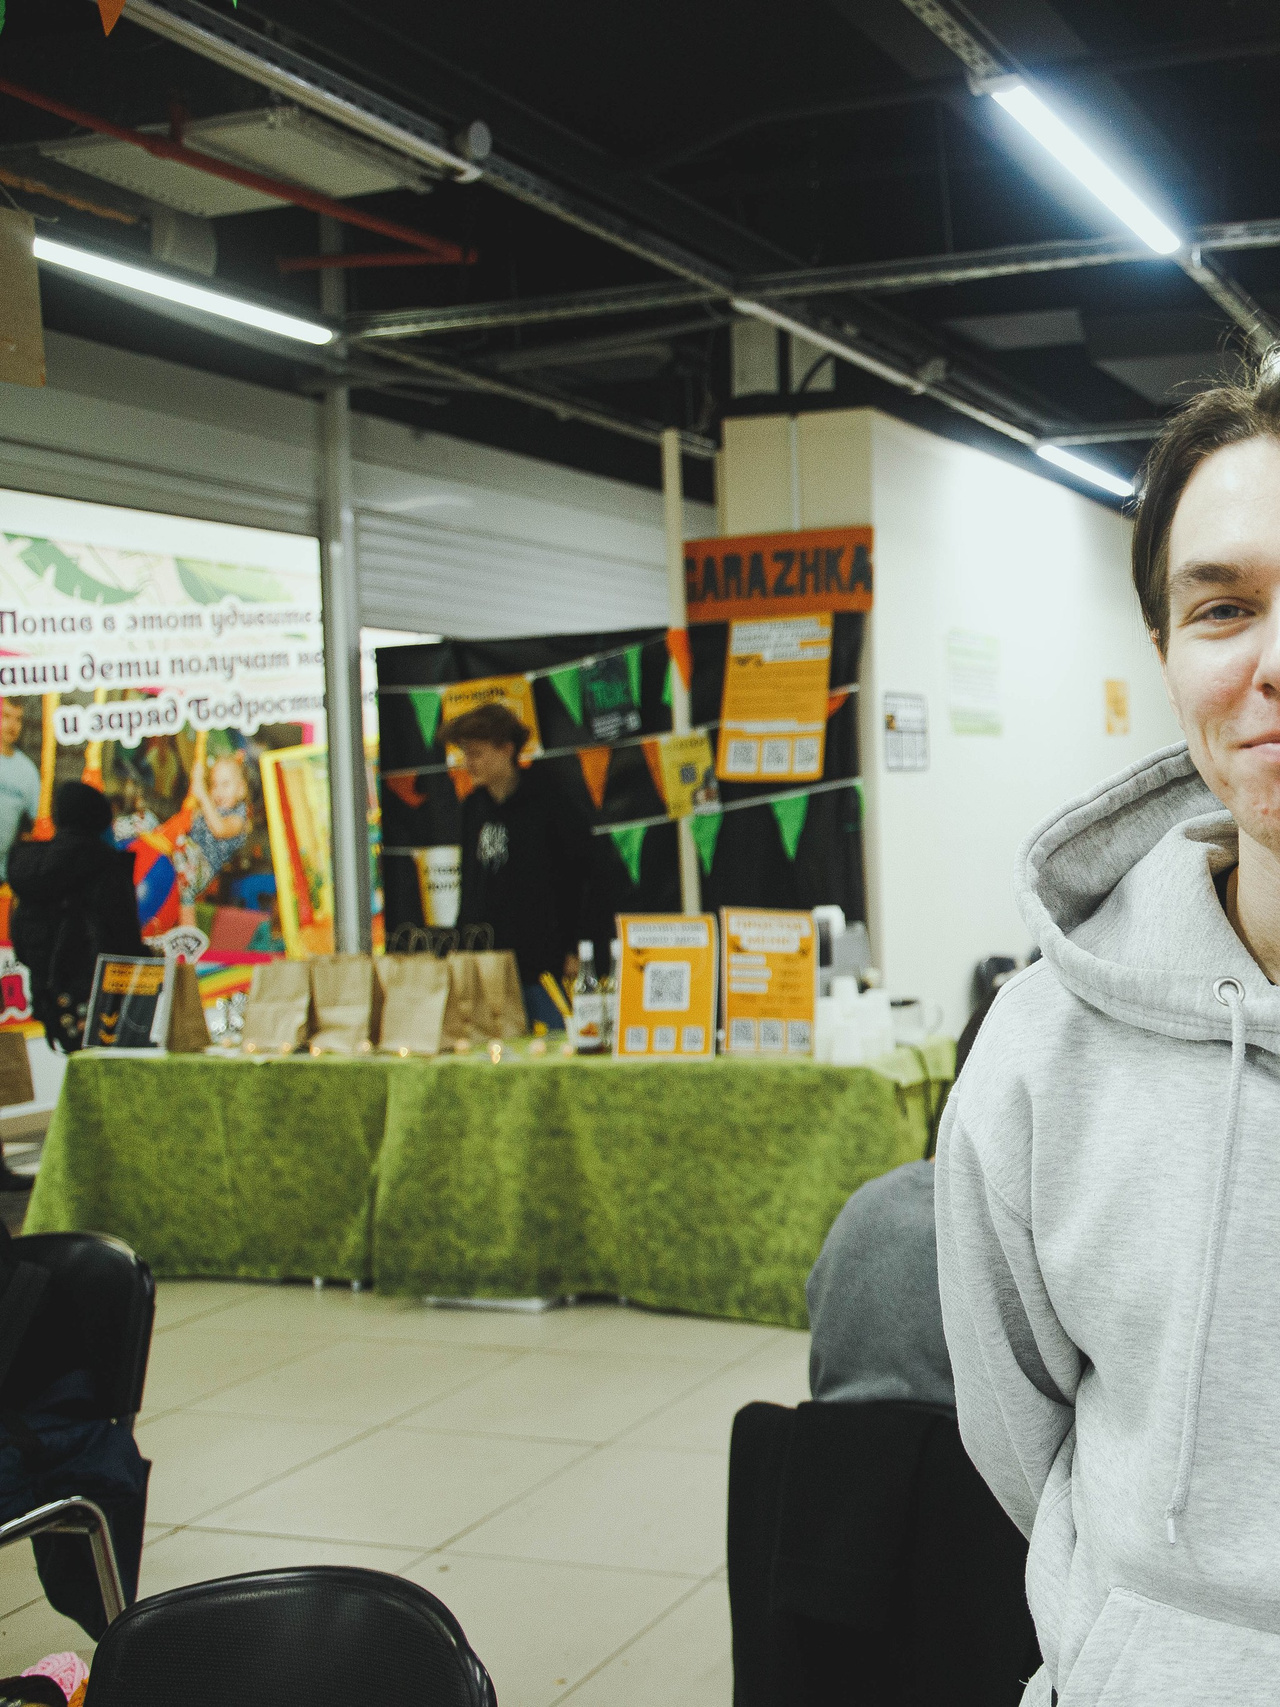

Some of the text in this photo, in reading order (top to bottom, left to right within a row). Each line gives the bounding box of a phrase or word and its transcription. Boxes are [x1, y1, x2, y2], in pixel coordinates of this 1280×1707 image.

[0, 610, 93, 634] Попав
[103, 615, 116, 632] в
[126, 612, 202, 631] этот
[81, 653, 160, 681] дети
[170, 651, 290, 682] получат
[62, 715, 79, 734] и
[91, 698, 178, 737] заряд
